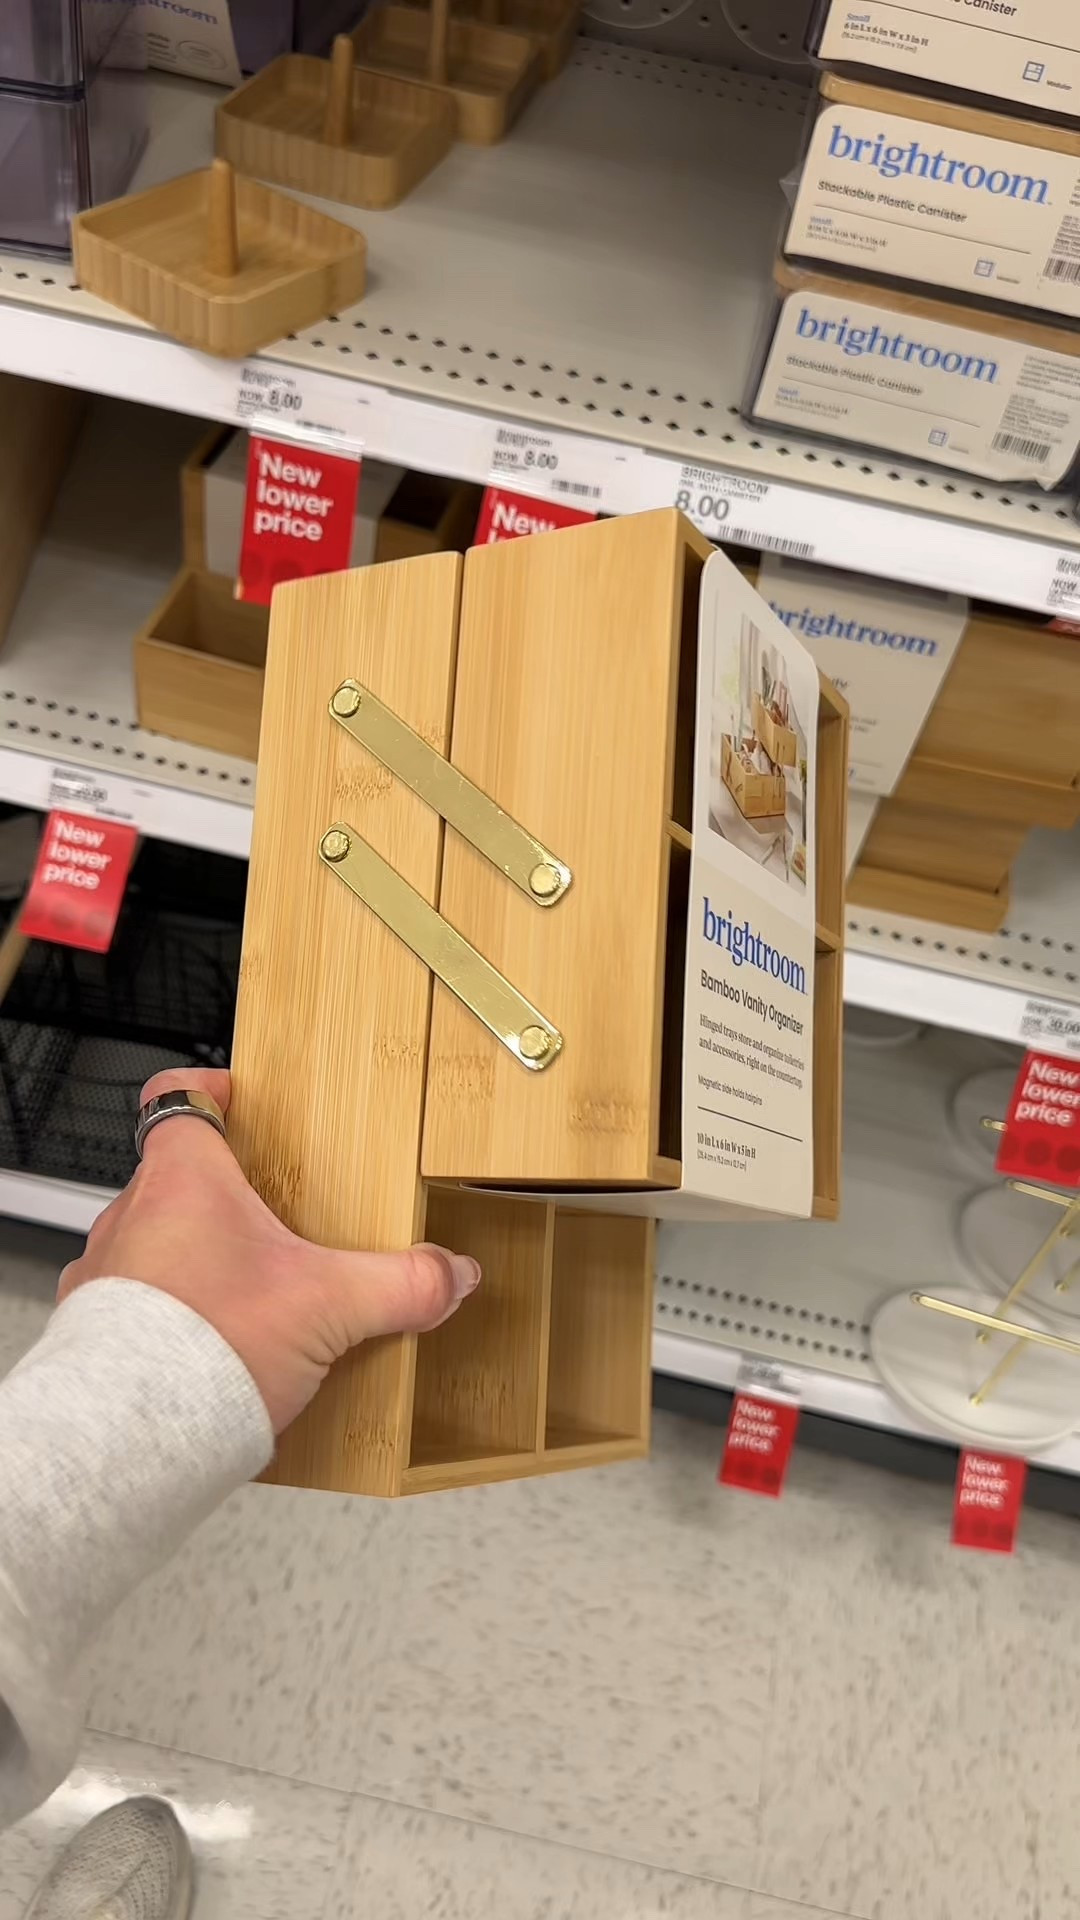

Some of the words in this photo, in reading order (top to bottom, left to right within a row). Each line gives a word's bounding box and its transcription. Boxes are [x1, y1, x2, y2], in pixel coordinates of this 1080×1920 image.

[827, 125, 1049, 205] brightroom
[818, 179, 875, 202] Stackable
[877, 194, 915, 212] Plastic
[917, 204, 968, 223] Canister
[795, 308, 999, 384] brightroom
[258, 451, 323, 489] New
[256, 480, 334, 518] lower
[675, 489, 730, 520] 8.00
[253, 509, 323, 542] price
[53, 818, 106, 850] New
[47, 840, 113, 872] lower
[42, 863, 100, 891] price
[703, 896, 806, 995] brightroom
[701, 969, 741, 1003] Bamboo
[741, 989, 768, 1023] Vanity
[768, 1004, 804, 1036] Organizer
[700, 1013, 723, 1034] Hinged
[723, 1025, 738, 1041] trays
[738, 1033, 752, 1047] store
[752, 1039, 763, 1051] and
[763, 1044, 784, 1061] organize
[699, 1037, 712, 1050] and
[746, 1054, 760, 1070] right
[760, 1062, 768, 1073] on
[767, 1064, 776, 1077] the
[698, 1073, 721, 1090] Magnetic
[722, 1082, 732, 1095] side
[732, 1086, 745, 1100] holds
[1027, 1059, 1080, 1088] New
[1014, 1100, 1075, 1128] price
[704, 1133, 711, 1147] in
[724, 1138, 731, 1152] in
[745, 1145, 751, 1158] in
[751, 1147, 756, 1159] H
[735, 1398, 776, 1422] New
[732, 1414, 782, 1439] lower
[728, 1431, 773, 1455] price
[964, 1453, 1005, 1477] New
[959, 1487, 1006, 1511] price
[961, 1472, 1011, 1495] lower
